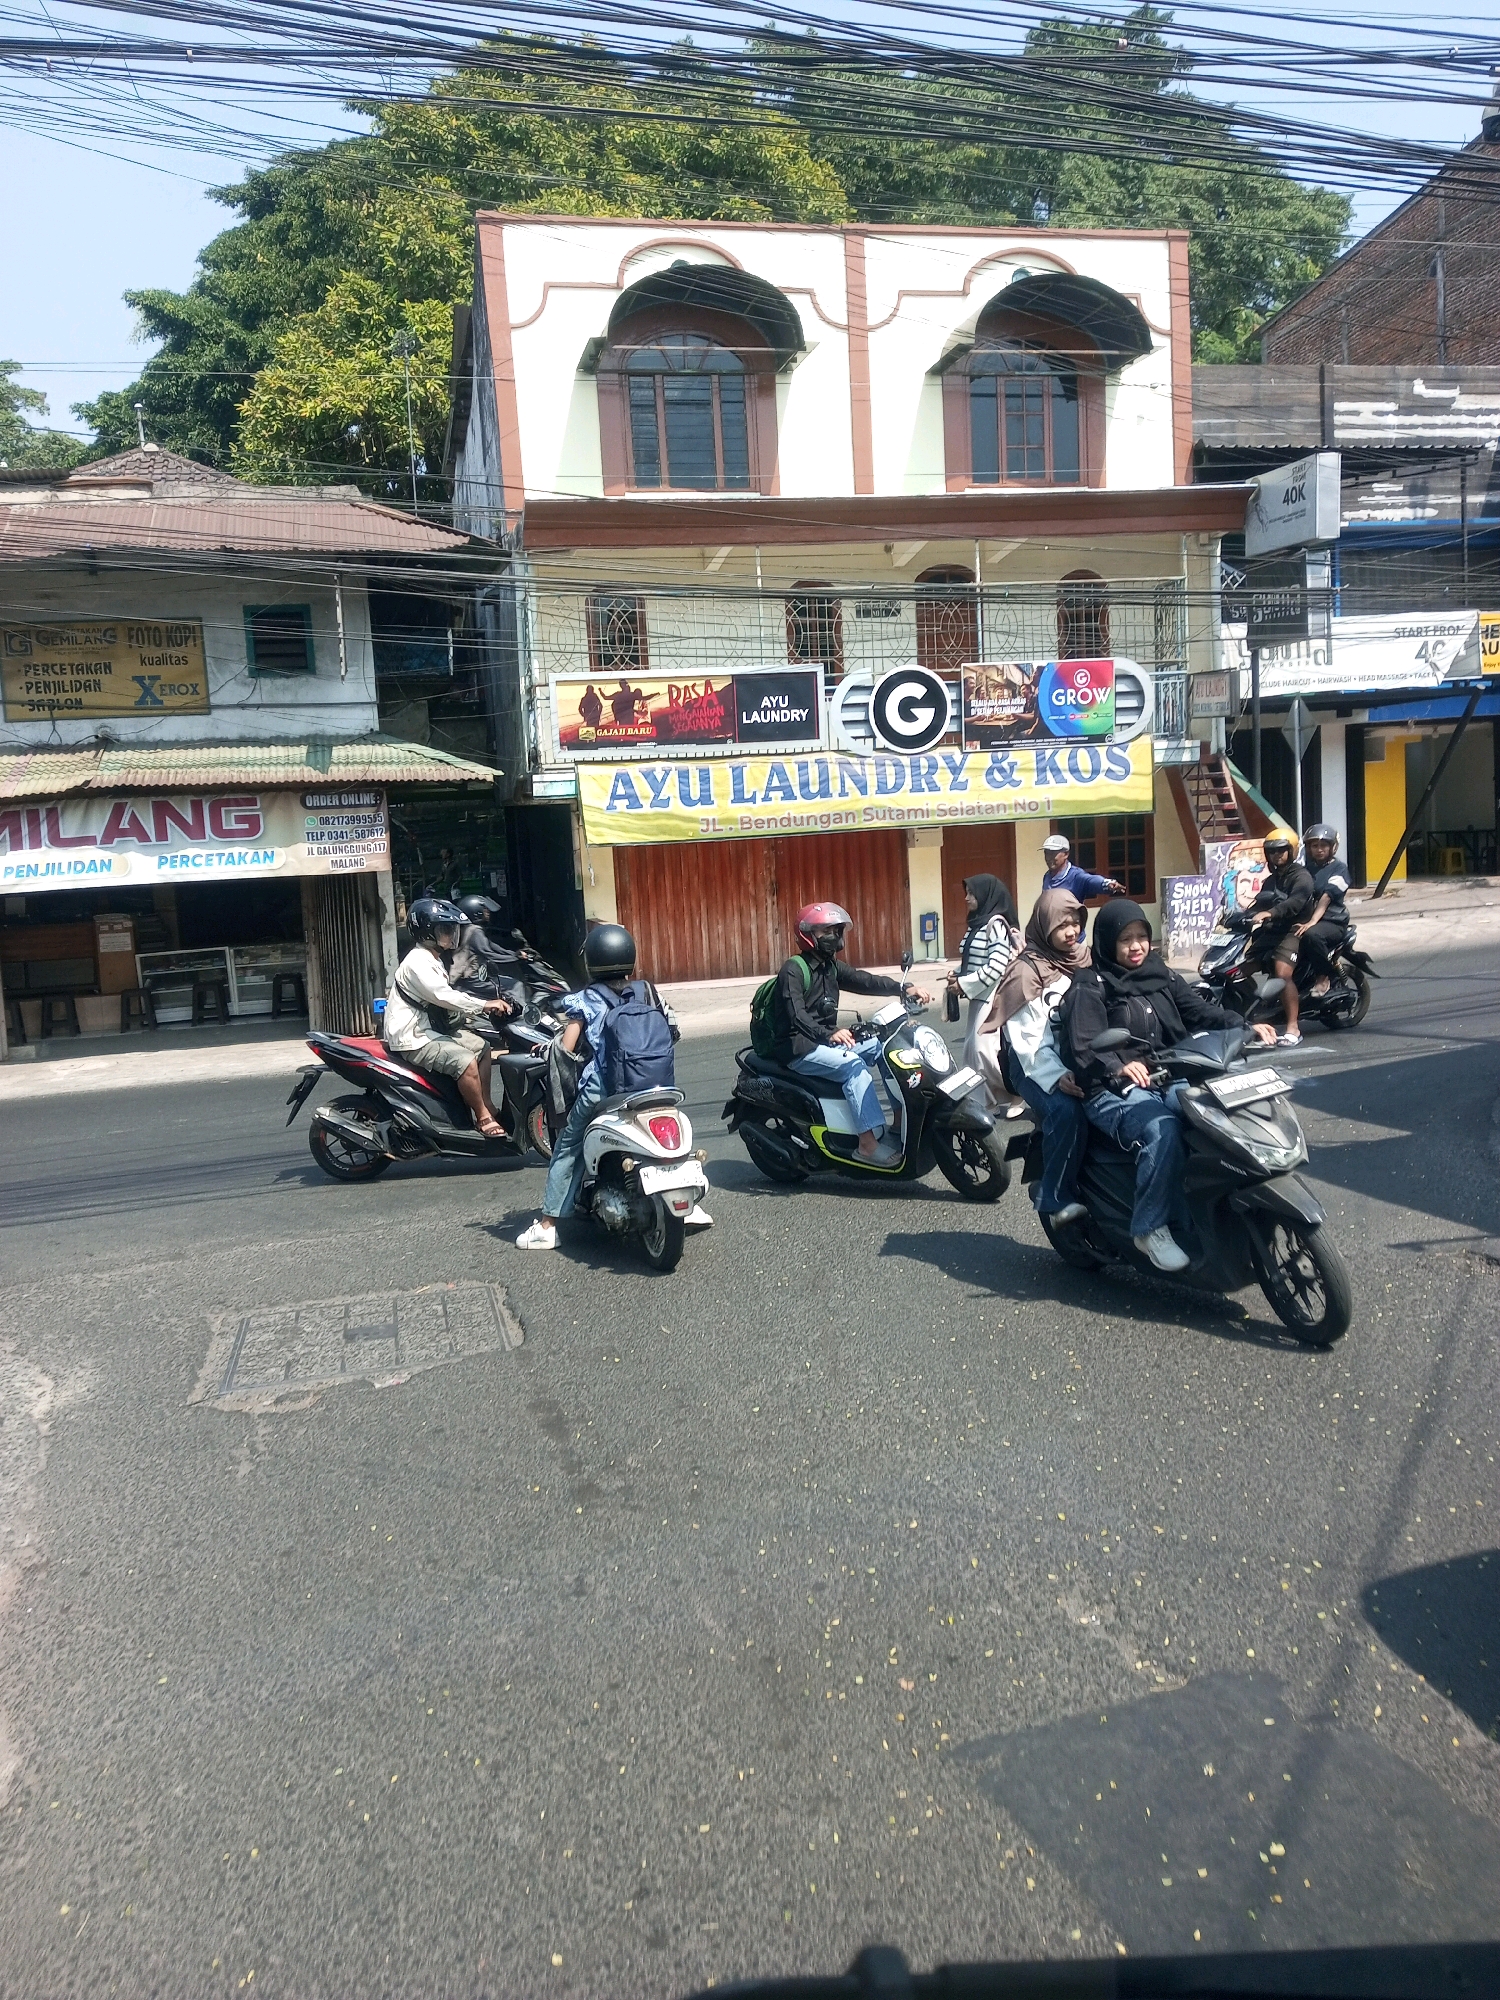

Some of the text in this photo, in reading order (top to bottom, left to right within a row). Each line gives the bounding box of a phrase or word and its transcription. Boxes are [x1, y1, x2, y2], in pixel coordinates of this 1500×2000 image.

[1282, 481, 1306, 506] 40K
[127, 625, 197, 648] FOTO KOPI
[139, 652, 189, 667] kualitas
[23, 661, 112, 677] PERCETAKAN
[24, 679, 102, 696] PENJILIDAN
[1282, 678, 1311, 687] HAIRCUT
[1317, 675, 1352, 685] HAIRWASH
[1358, 674, 1375, 683] HEAD
[1376, 672, 1408, 682] MASSAGE
[131, 674, 200, 706] XEROX
[668, 679, 719, 710] RASA
[1051, 686, 1111, 706] GROW
[27, 697, 84, 712] SABLON
[760, 694, 789, 709] AYU
[885, 681, 937, 736] G
[742, 708, 809, 724] LAUNDRY
[627, 726, 653, 736] BARU
[605, 744, 1130, 811] AYU LAUNDRY & KOS
[305, 793, 340, 807] ORDER
[319, 812, 384, 827] 082173999555
[740, 808, 857, 830] Bendungan
[862, 803, 930, 822] Sutami
[936, 800, 1008, 817] Selatan
[1013, 800, 1039, 813] No
[1042, 798, 1051, 811] 1
[305, 830, 326, 842] TELP.
[307, 842, 386, 856] JL GALUNGGUNG 117
[157, 850, 275, 870] PERCETAKAN
[331, 857, 365, 869] MALANG
[3, 859, 113, 879] PENJILIDAN
[1172, 878, 1214, 899] SHOW
[1170, 897, 1214, 915] THEM
[1173, 915, 1211, 930] YOUR
